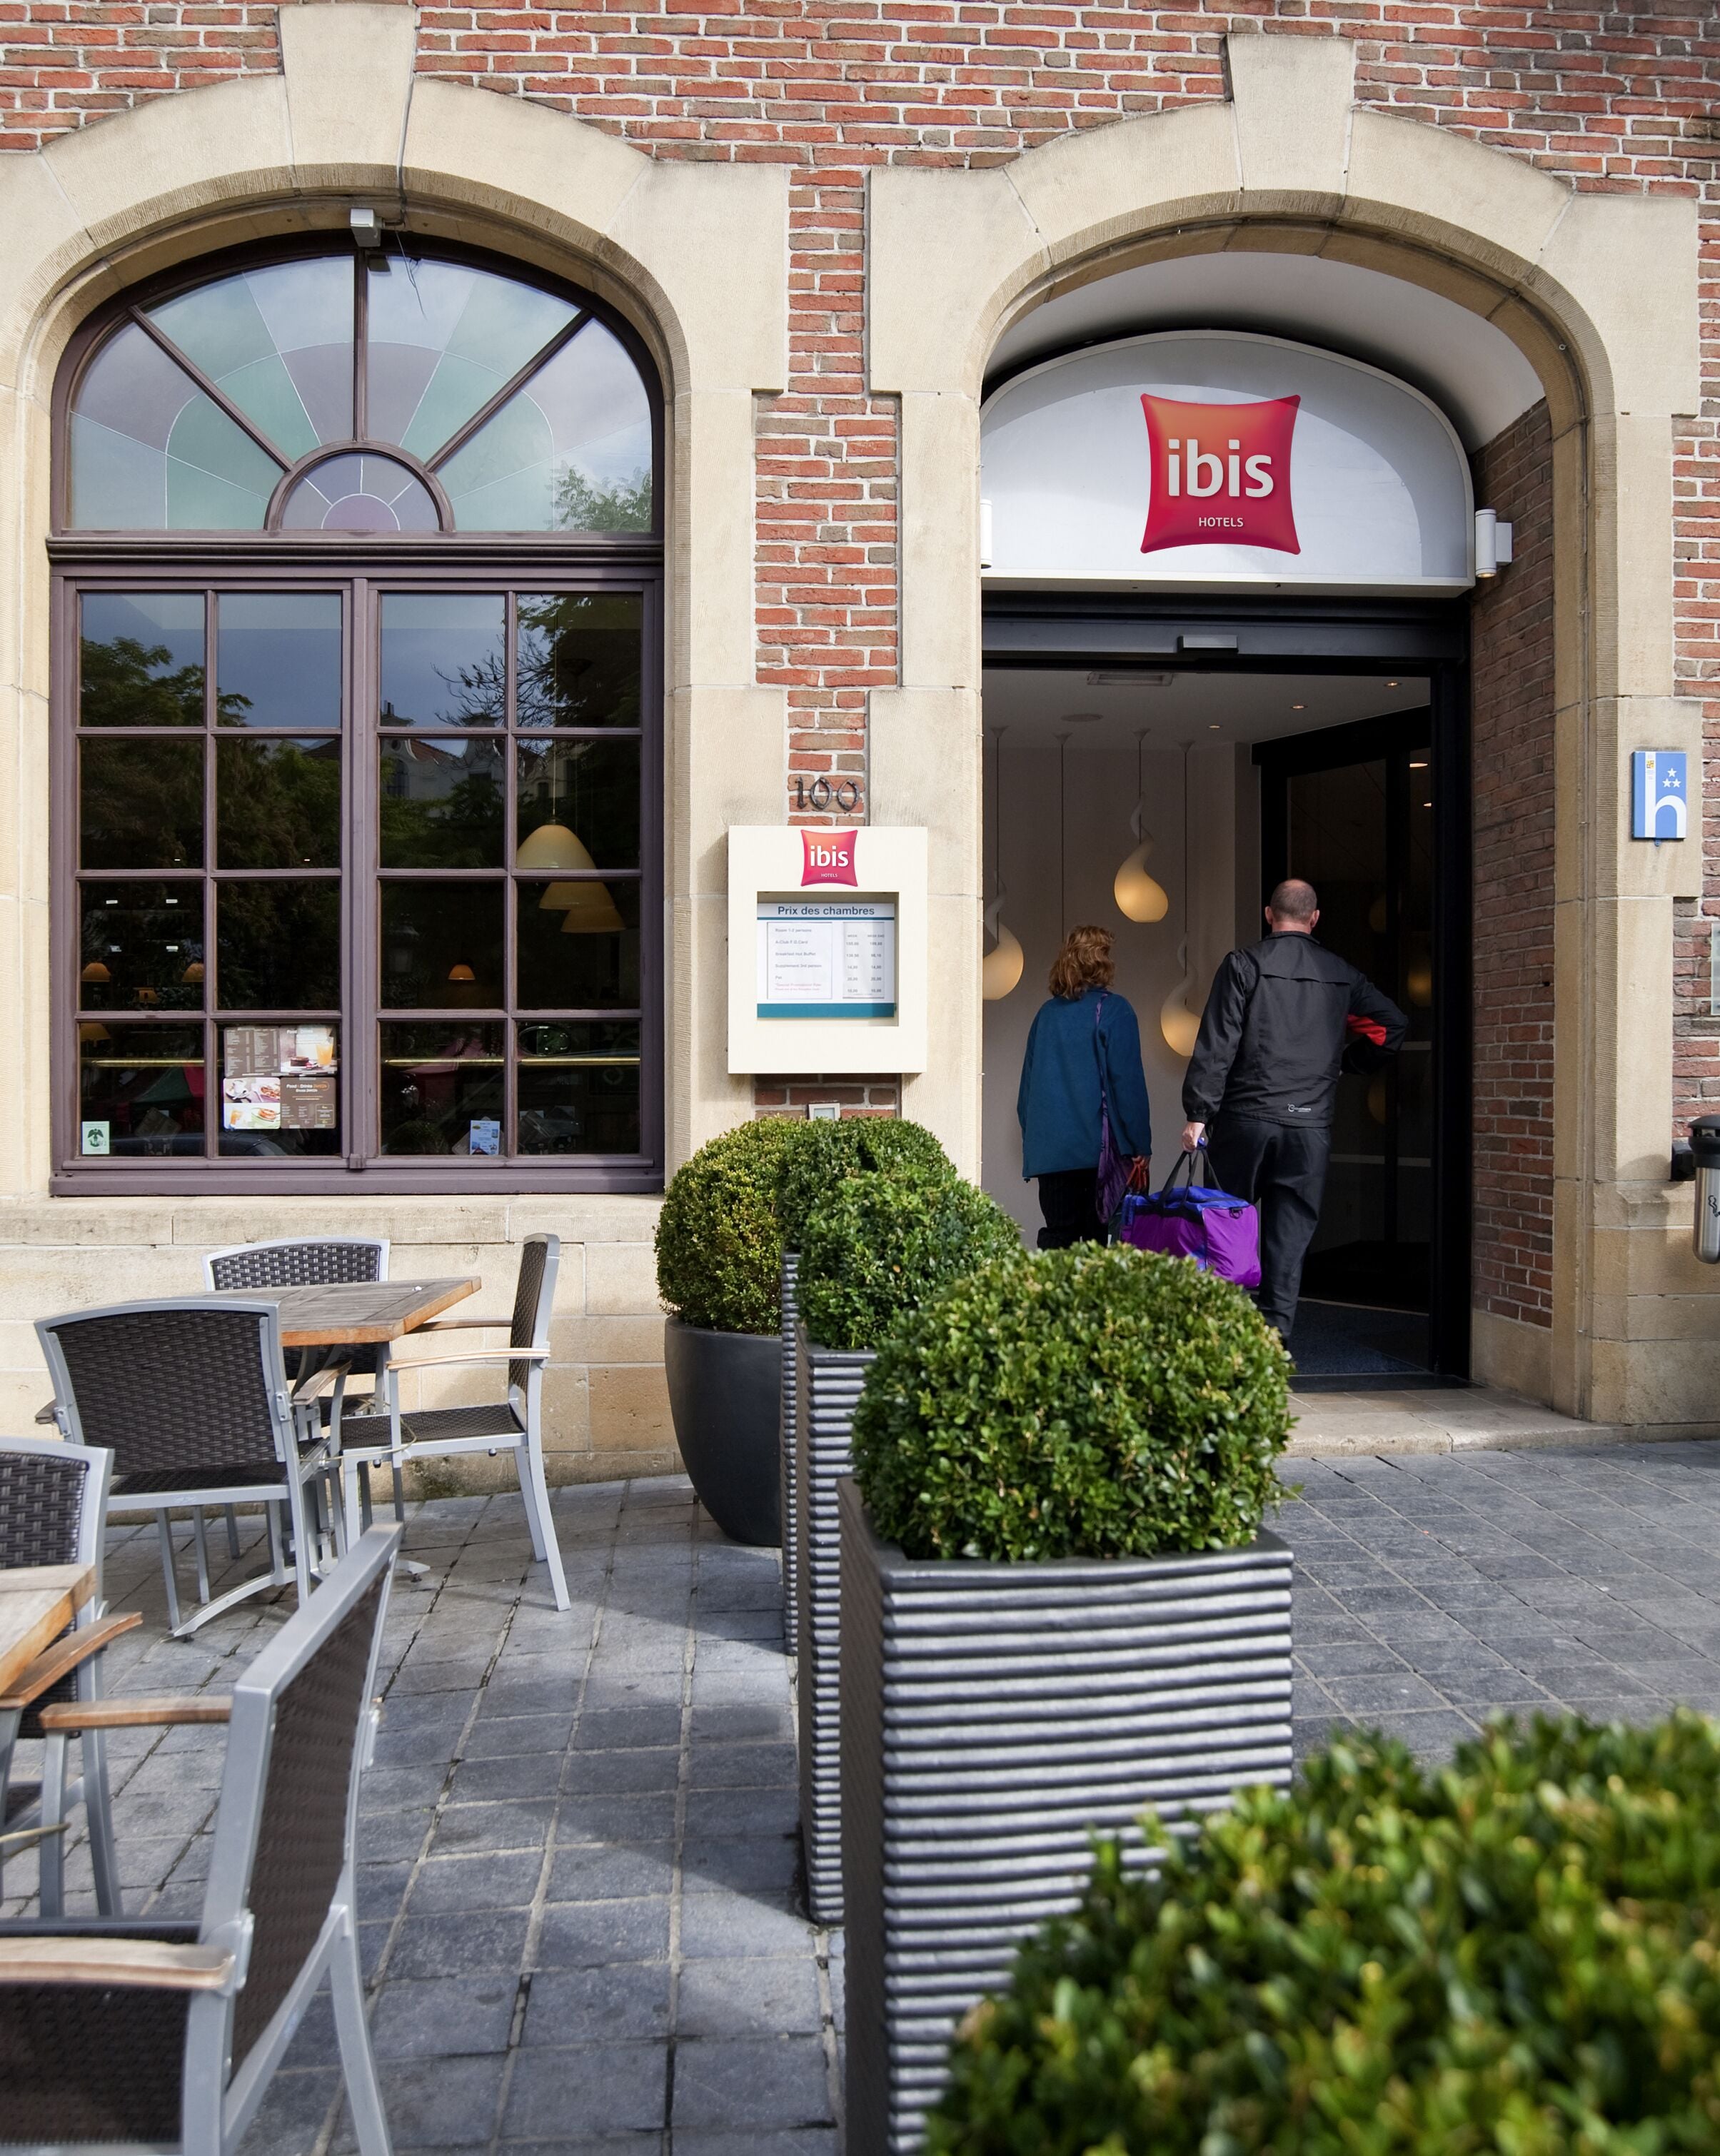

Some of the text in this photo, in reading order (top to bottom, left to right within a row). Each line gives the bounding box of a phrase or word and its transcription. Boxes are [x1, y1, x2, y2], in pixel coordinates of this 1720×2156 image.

[1168, 438, 1274, 498] ibis
[1198, 517, 1244, 528] HOTELS
[795, 776, 860, 812] 100
[810, 845, 849, 867] ibis
[778, 906, 875, 915] Prix des chambres
